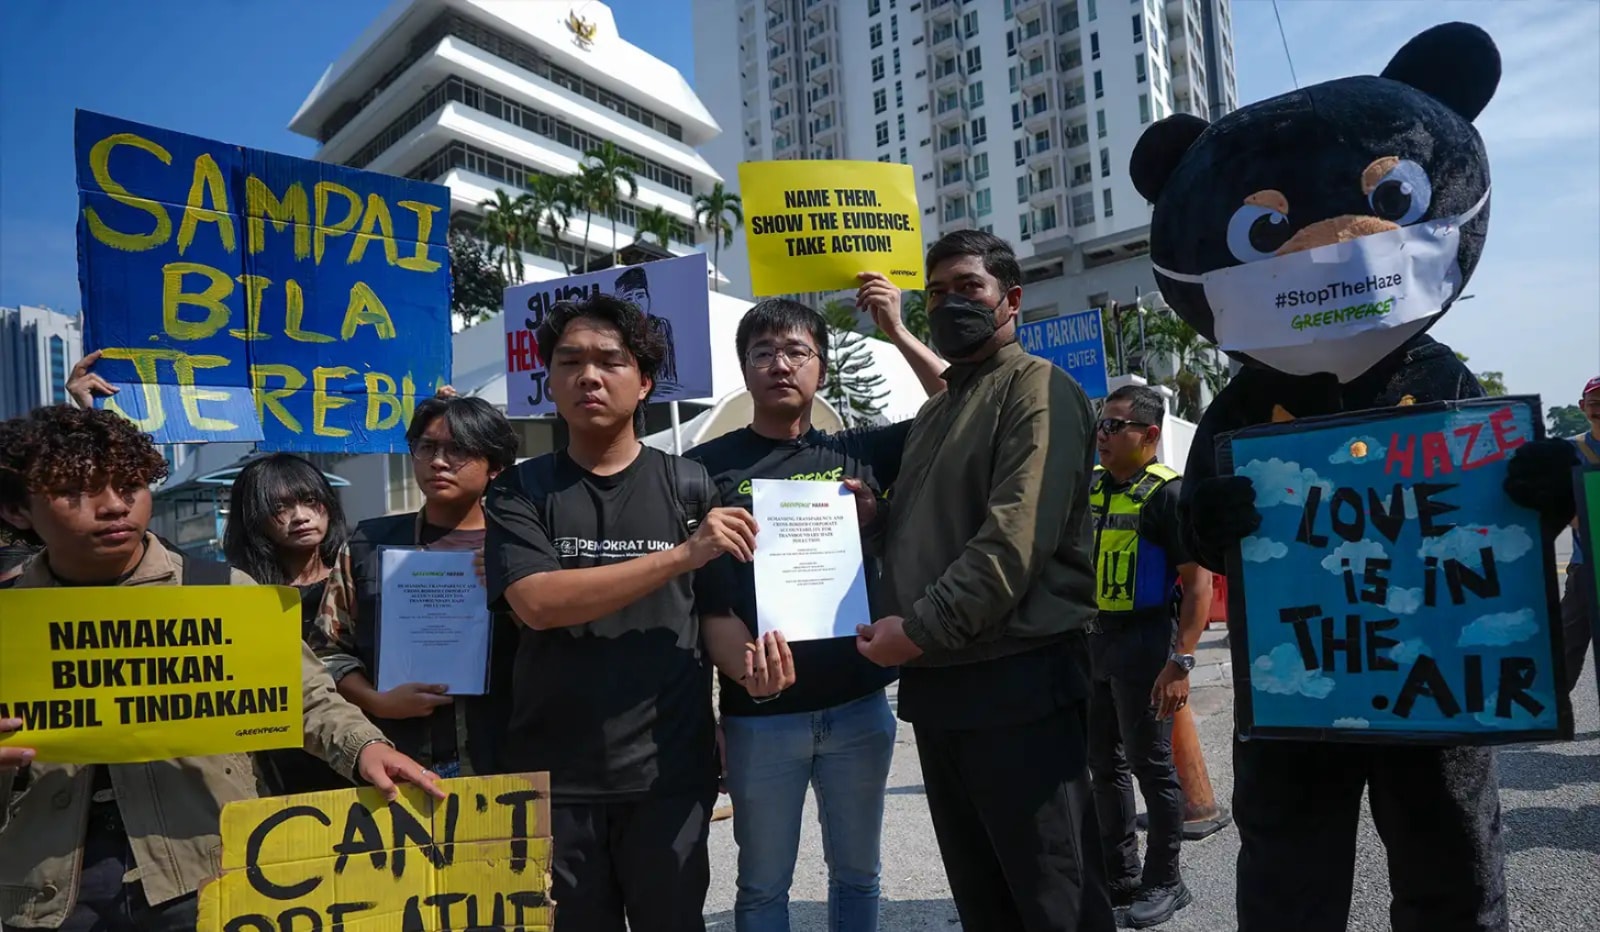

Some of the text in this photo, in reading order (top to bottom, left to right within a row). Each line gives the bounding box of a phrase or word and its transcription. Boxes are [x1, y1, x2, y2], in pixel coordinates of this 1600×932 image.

[84, 132, 444, 273] SAMPAI
[784, 188, 882, 208] NAME THEM.
[752, 211, 915, 235] SHOW THE EVIDENCE.
[785, 235, 893, 256] TAKE ACTION!
[162, 262, 397, 344] BILA
[1274, 272, 1403, 309] #StopTheHaze
[1290, 297, 1395, 331] GREENPEACE
[1019, 314, 1099, 352] CAR PARKING
[1068, 349, 1098, 369] ENTER
[1385, 407, 1526, 478] HAZE
[1296, 481, 1460, 549] LOVE
[578, 538, 675, 551] DEMOKRAT UKM
[49, 618, 233, 650] NAMAKAN.
[1280, 604, 1400, 673] THE
[52, 655, 234, 689] BUKTIKAN.
[114, 686, 289, 725] TINDAKAN!
[235, 725, 291, 737] GREENPEACE
[246, 790, 542, 900] CAN'T
